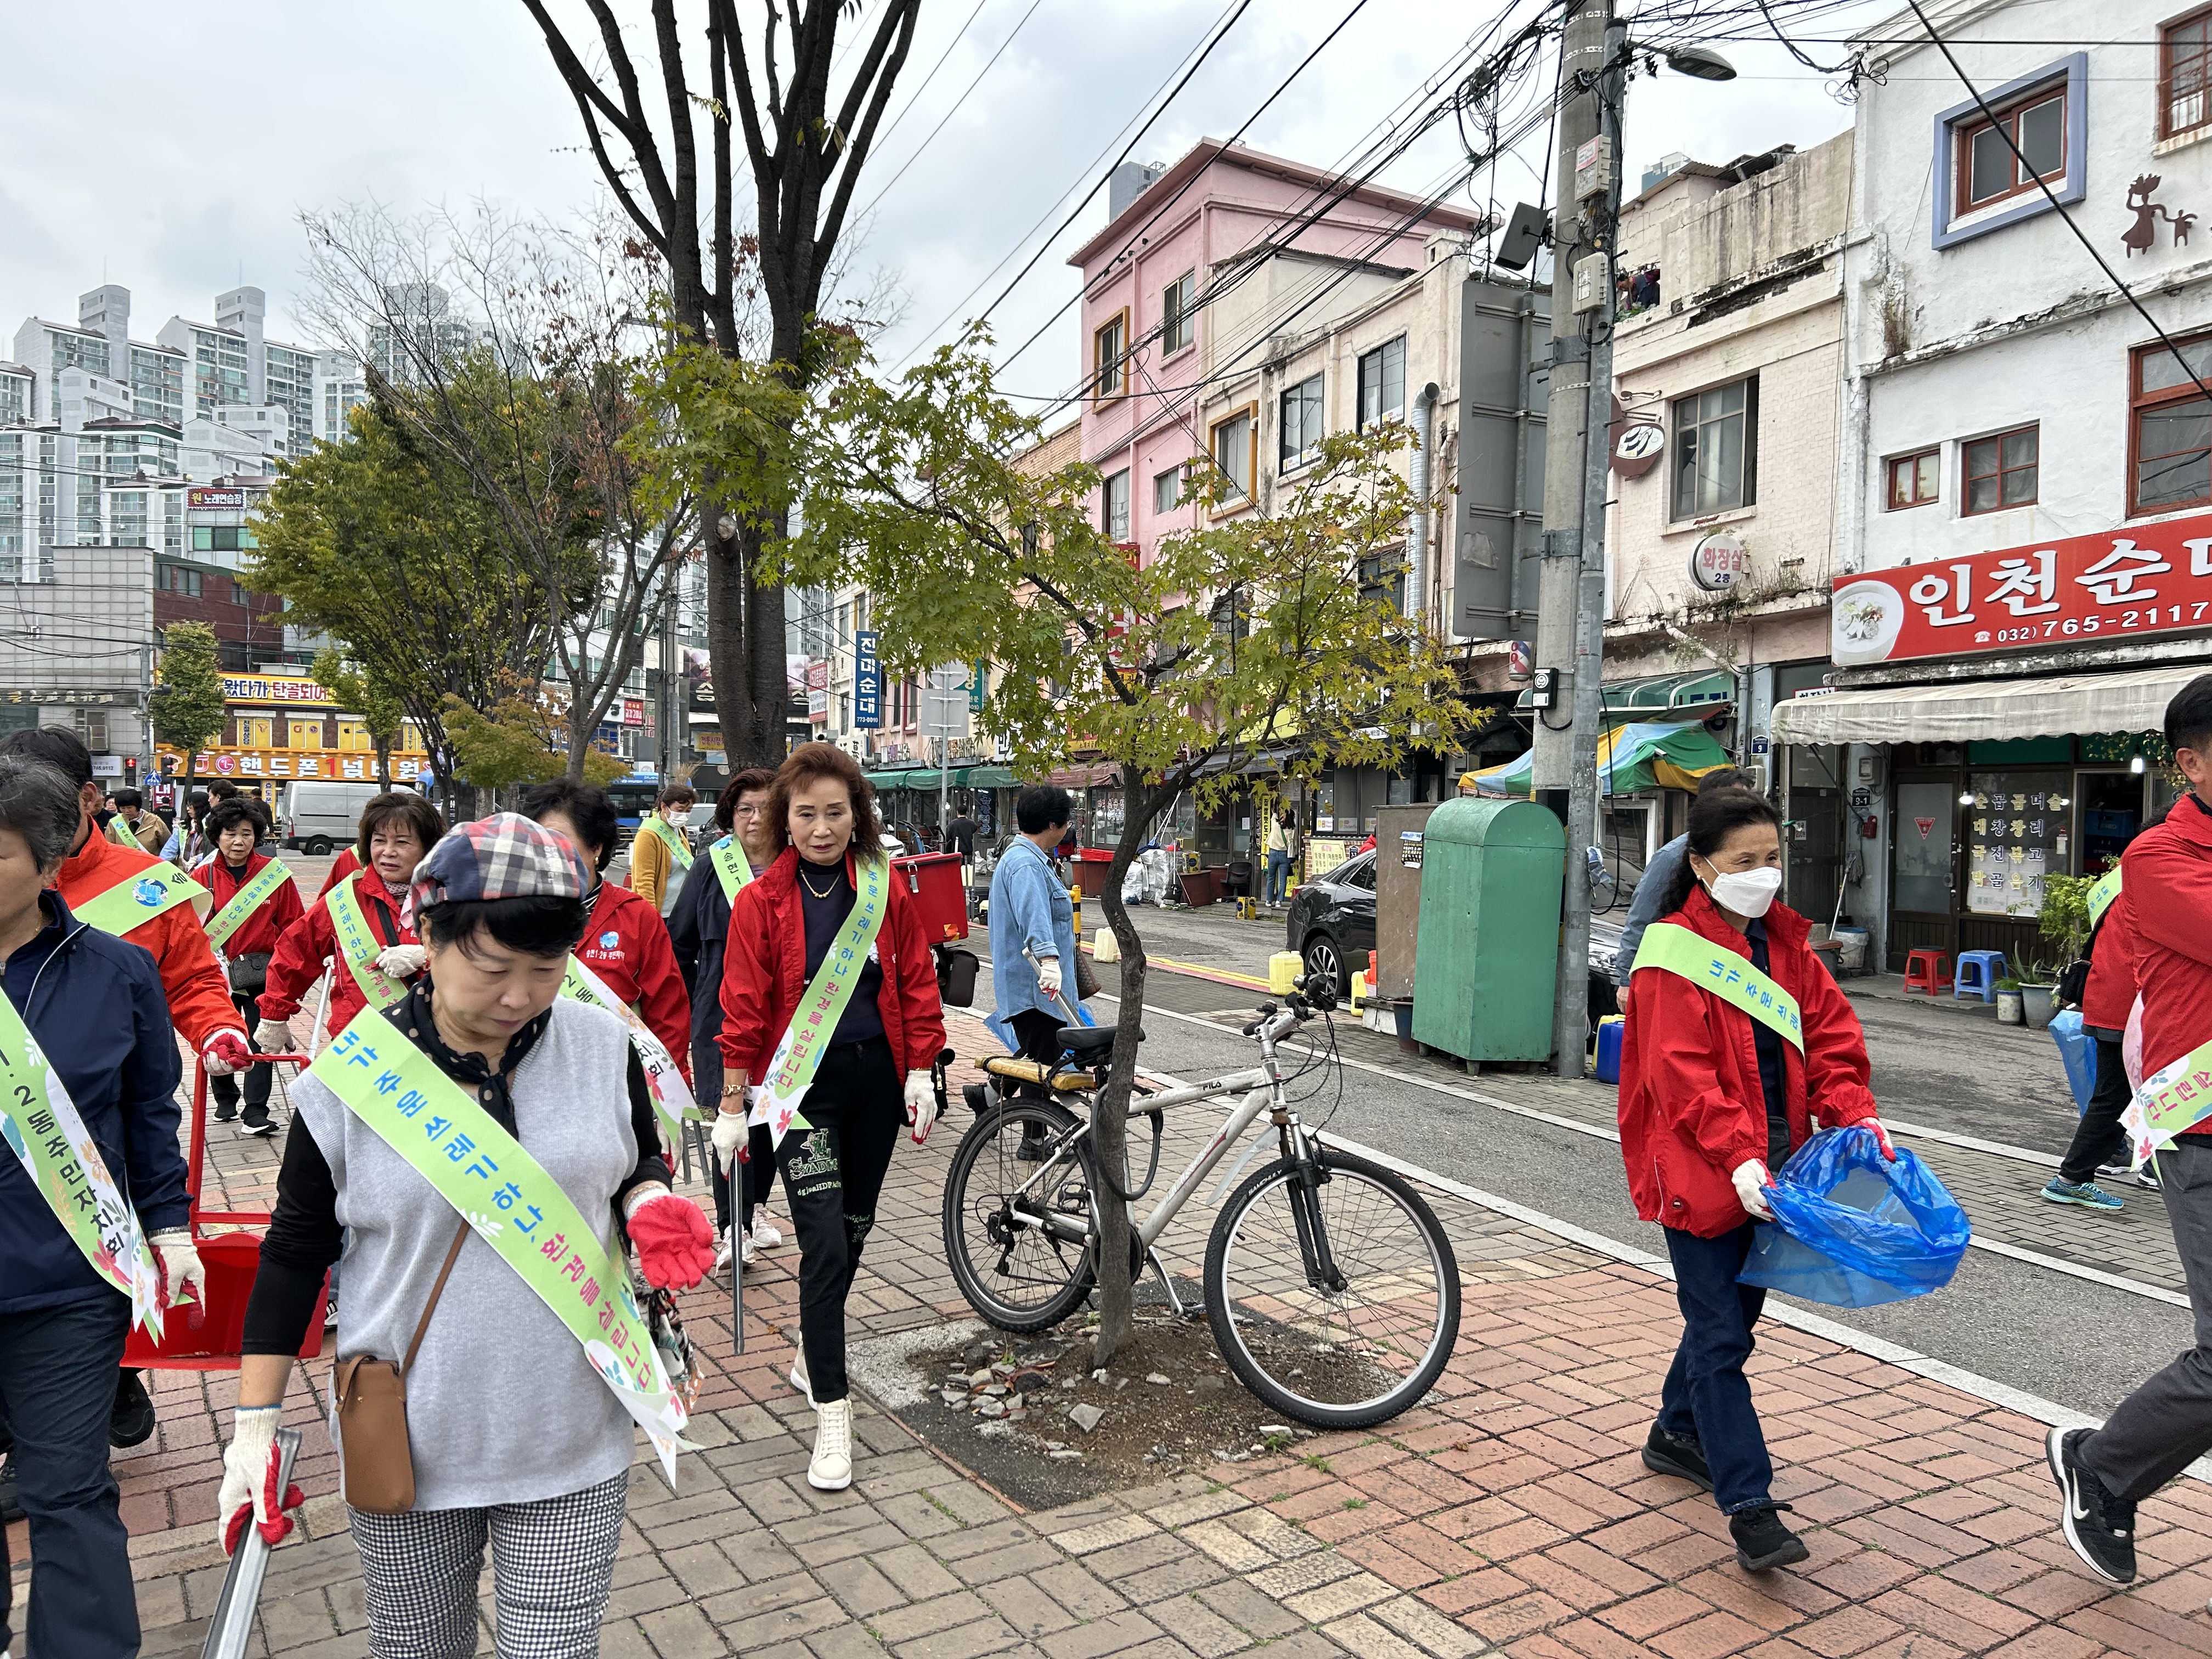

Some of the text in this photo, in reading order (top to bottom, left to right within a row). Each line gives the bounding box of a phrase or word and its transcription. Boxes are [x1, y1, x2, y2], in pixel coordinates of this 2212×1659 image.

[191, 493, 242, 504] 원 노래연습장
[1702, 548, 1742, 571] 화장실
[1714, 573, 1730, 583] 2층
[1758, 744, 1762, 753] 9
[1855, 797, 1867, 805] 9-1
[1971, 792, 1988, 887] 순대국밥
[1989, 793, 2007, 889] 곱창전골
[2009, 793, 2027, 890] 곱창볶음
[261, 873, 275, 887] 주운
[868, 870, 878, 898] 주운
[243, 886, 262, 906] 쓰레기
[339, 902, 357, 934] 쓰레기
[851, 902, 874, 945] 쓰레기
[808, 981, 840, 1026] 환경을
[1709, 959, 1803, 1036] 내가 주운 쓰레
[778, 1029, 816, 1088] 살립니다
[1203, 1081, 1222, 1091] FILA
[332, 1030, 379, 1068] 내가
[374, 1069, 428, 1119] 주운
[424, 1115, 499, 1180] 쓰레기
[540, 1234, 600, 1304] 환경을
[599, 1301, 652, 1389] 살립니다
